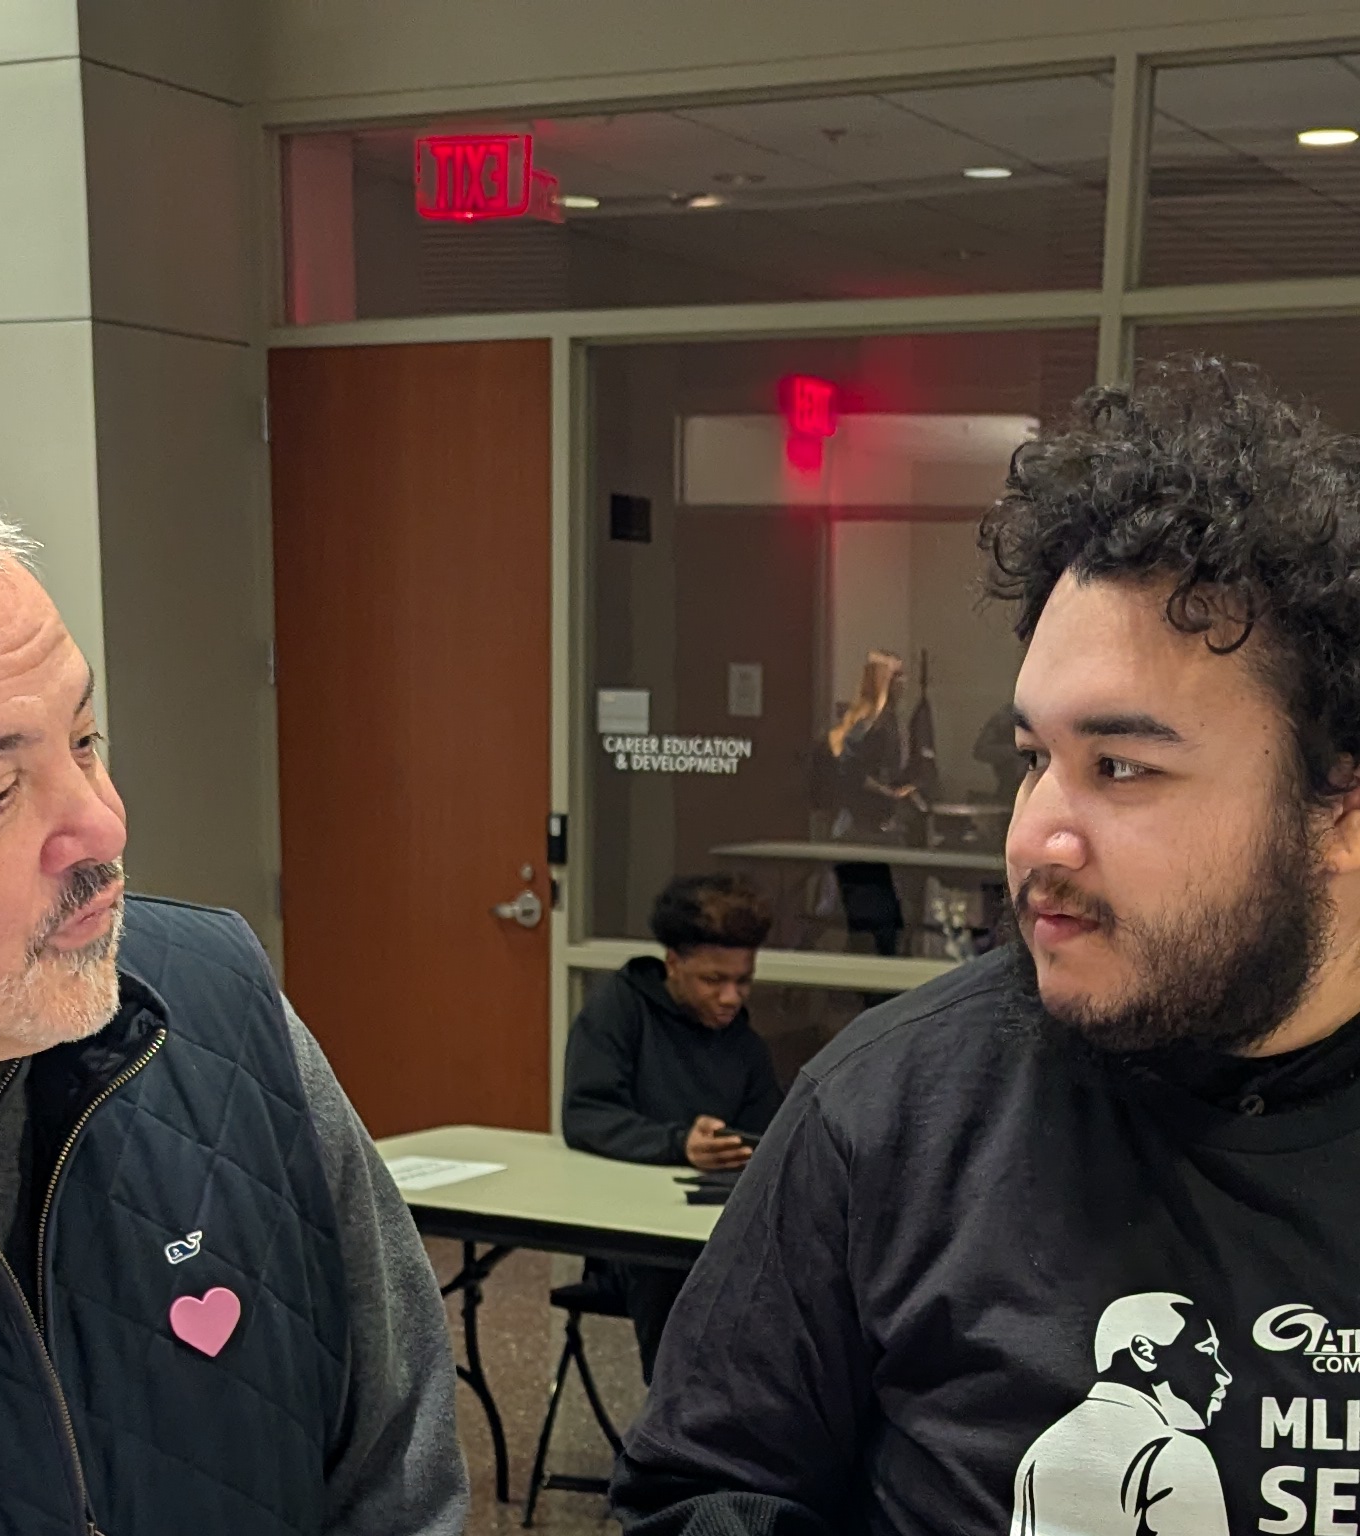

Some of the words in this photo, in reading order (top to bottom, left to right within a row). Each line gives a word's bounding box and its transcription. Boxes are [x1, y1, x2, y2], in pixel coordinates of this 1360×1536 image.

[602, 735, 660, 754] CAREER
[663, 735, 753, 758] EDUCATION
[614, 753, 629, 771] &
[630, 754, 739, 774] DEVELOPMENT
